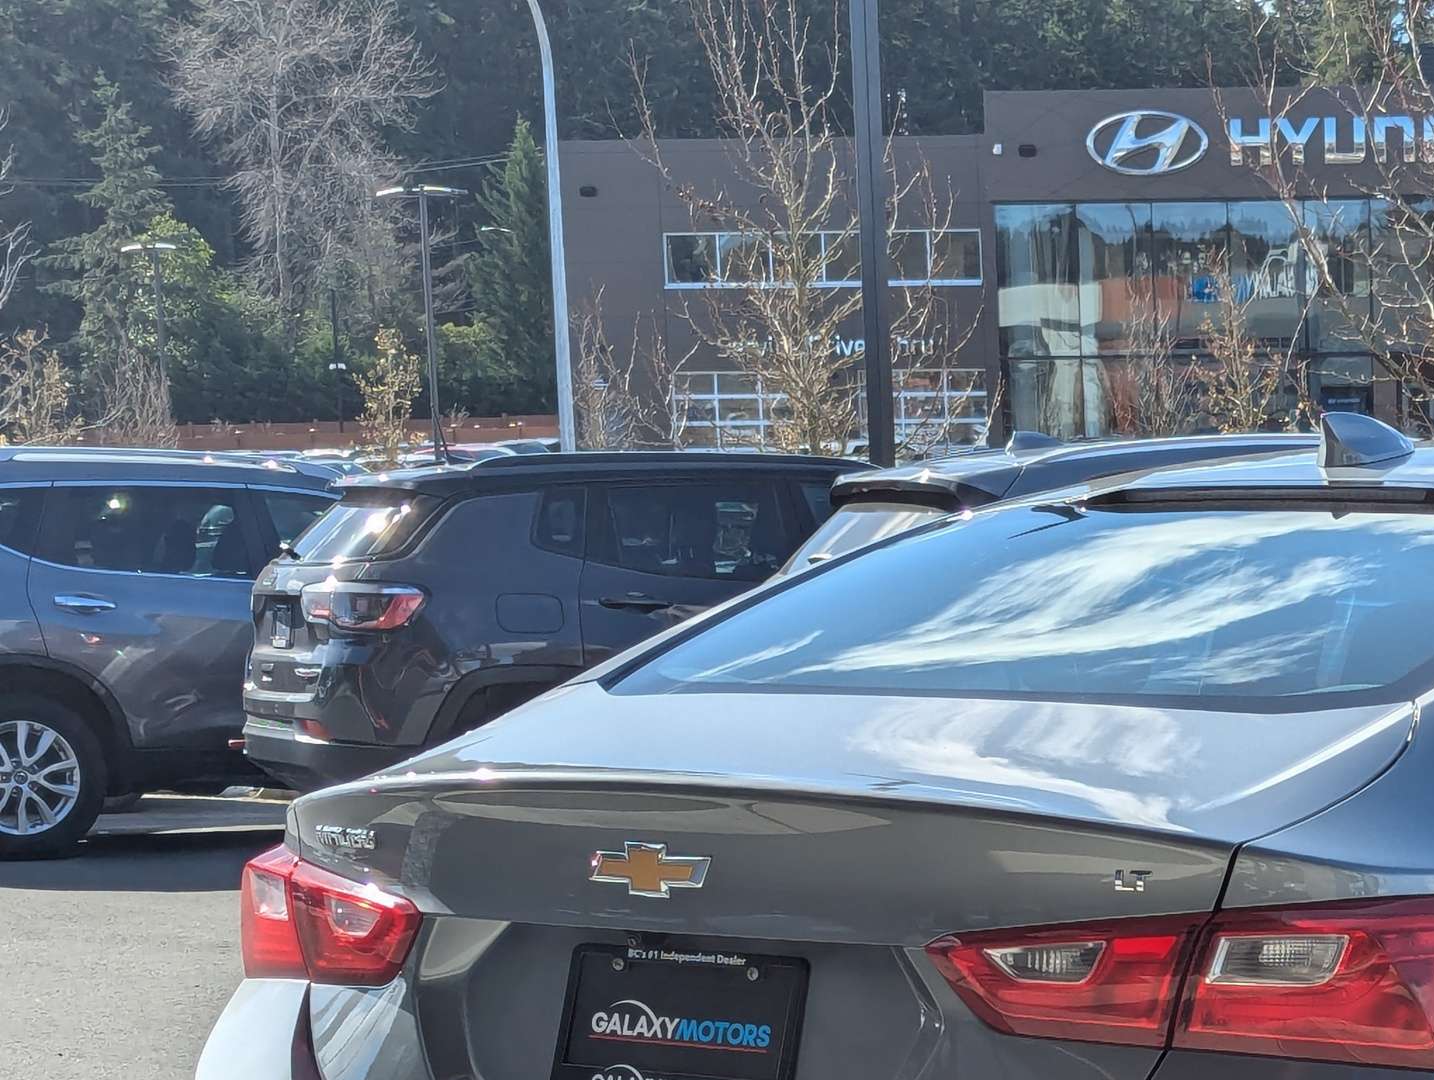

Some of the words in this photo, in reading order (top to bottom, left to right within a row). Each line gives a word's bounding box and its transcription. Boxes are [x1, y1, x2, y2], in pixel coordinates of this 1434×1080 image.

[1114, 870, 1153, 892] LT
[660, 950, 716, 965] Independent
[716, 954, 746, 967] Dealer
